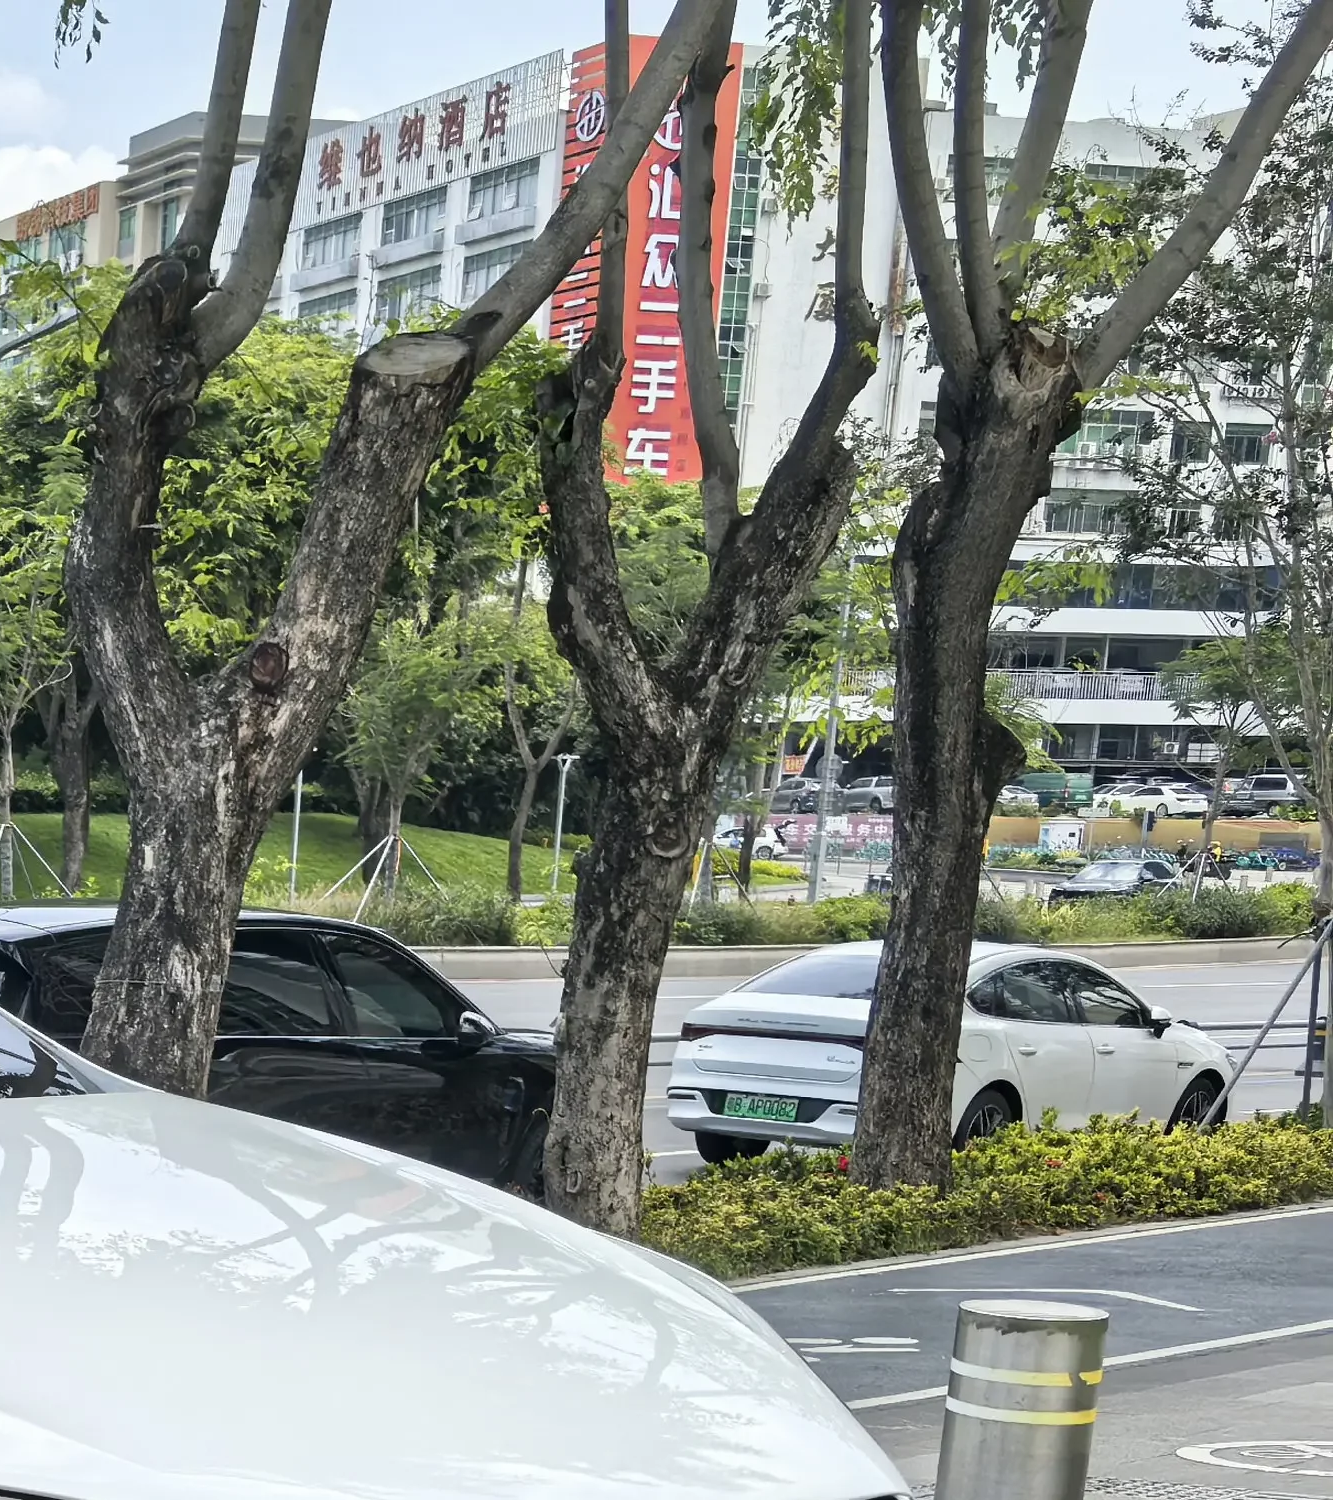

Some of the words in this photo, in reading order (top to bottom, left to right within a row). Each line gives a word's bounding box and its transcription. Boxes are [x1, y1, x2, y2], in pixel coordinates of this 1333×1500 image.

[317, 80, 512, 193] 维也纳酒店
